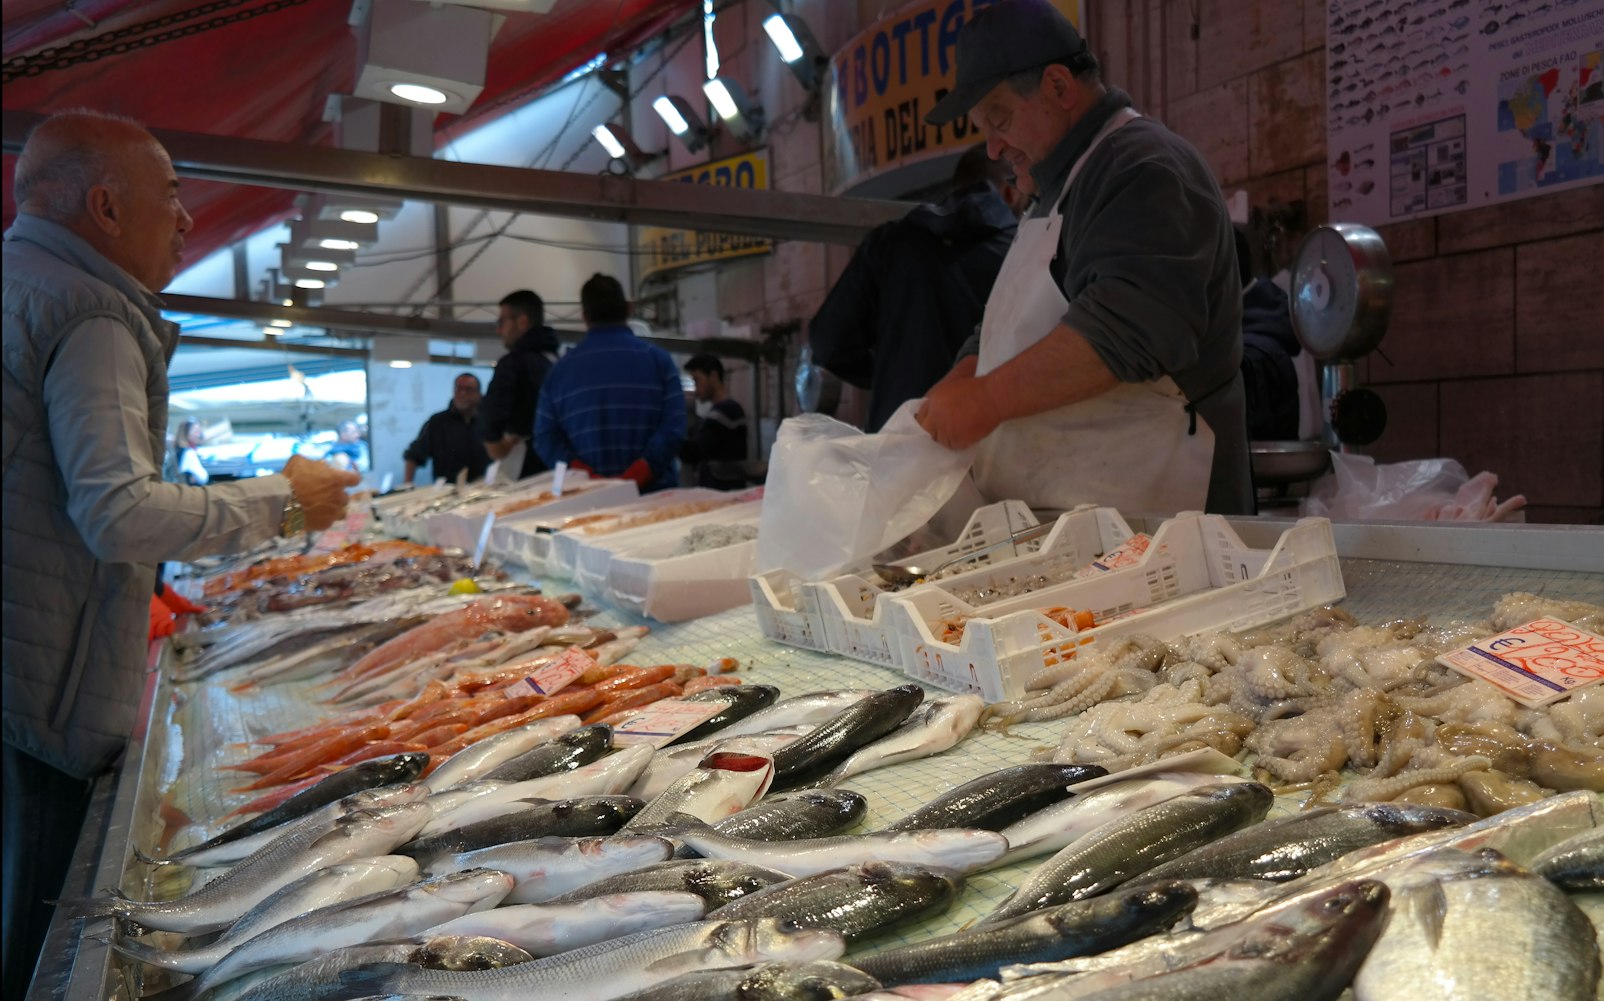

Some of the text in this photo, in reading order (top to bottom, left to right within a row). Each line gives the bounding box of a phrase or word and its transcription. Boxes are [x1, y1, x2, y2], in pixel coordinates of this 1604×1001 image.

[854, 0, 998, 107] BOTTA
[1499, 50, 1577, 82] ZONE DI PESCA FAO
[885, 97, 926, 161] DEL
[1489, 637, 1526, 650] €
